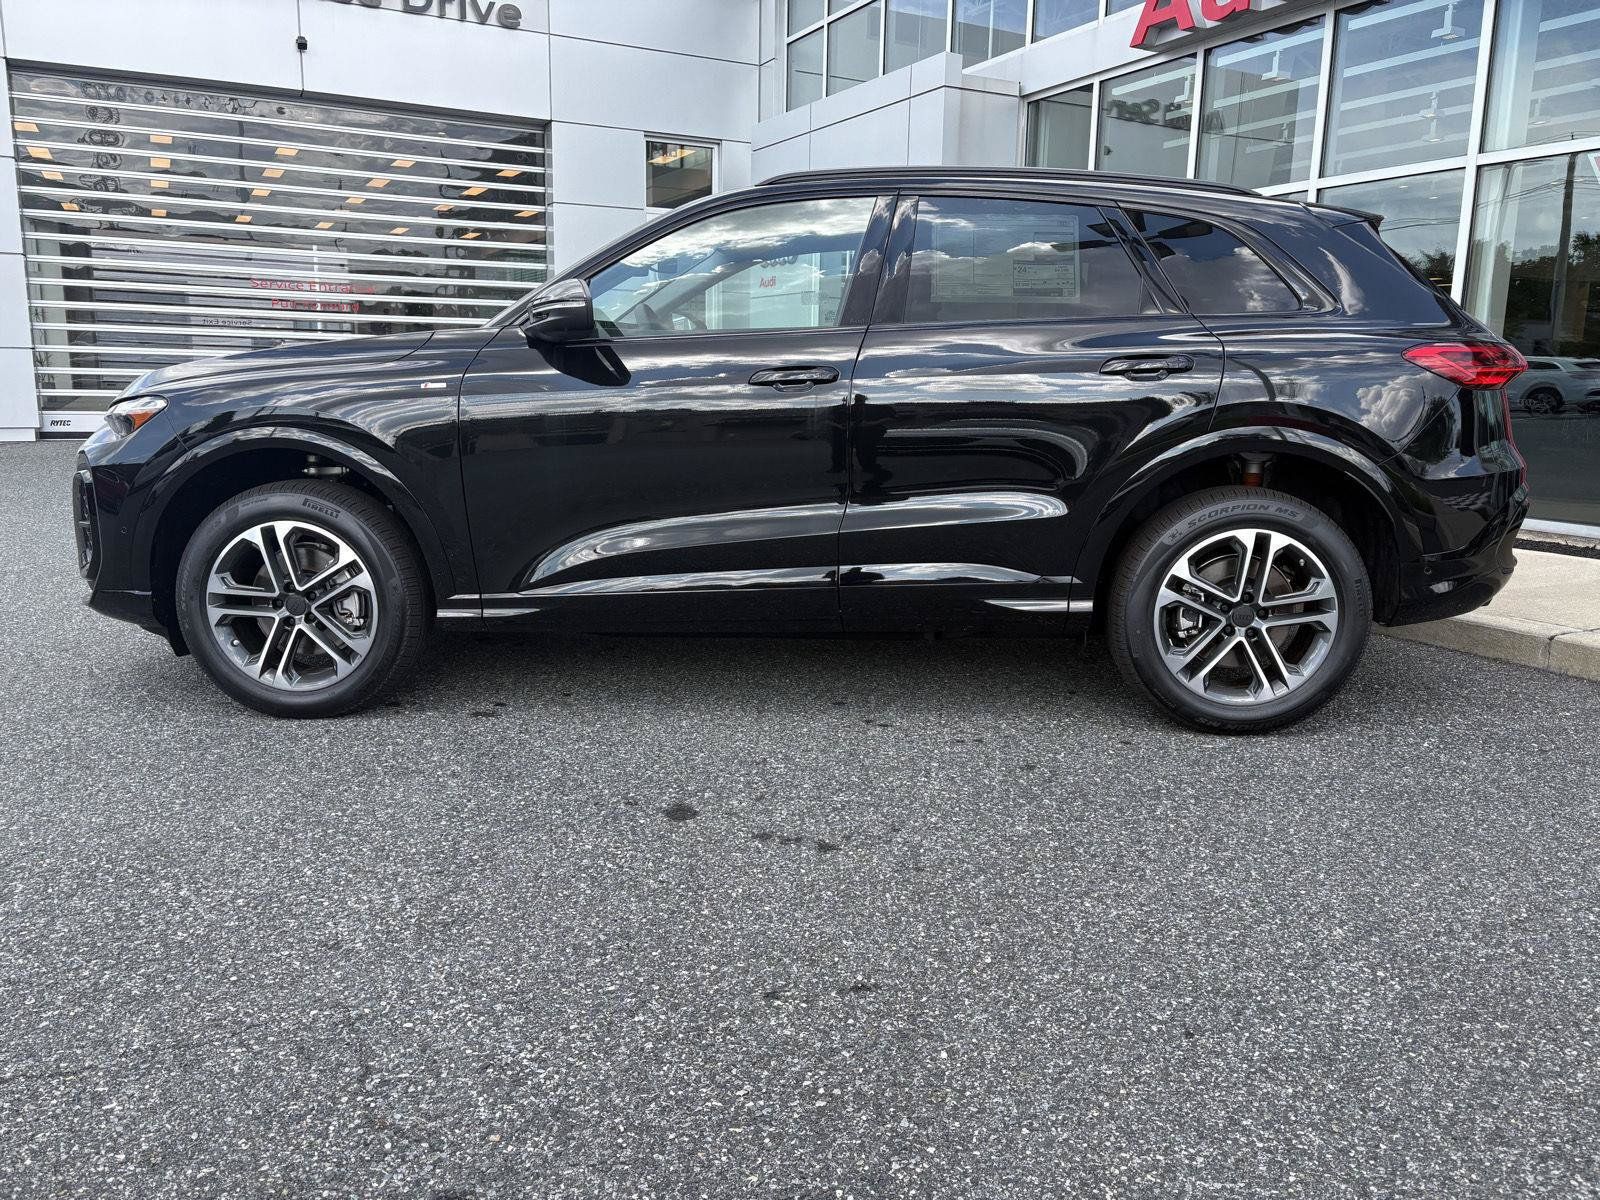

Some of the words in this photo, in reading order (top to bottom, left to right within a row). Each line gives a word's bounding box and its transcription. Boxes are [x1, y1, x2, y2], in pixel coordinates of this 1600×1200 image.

[250, 278, 304, 290] Service
[759, 275, 777, 289] Audi
[50, 419, 72, 427] RYTEC
[302, 497, 341, 519] PIRELLI
[1187, 503, 1271, 529] SCORPION
[1275, 507, 1300, 518] MS
